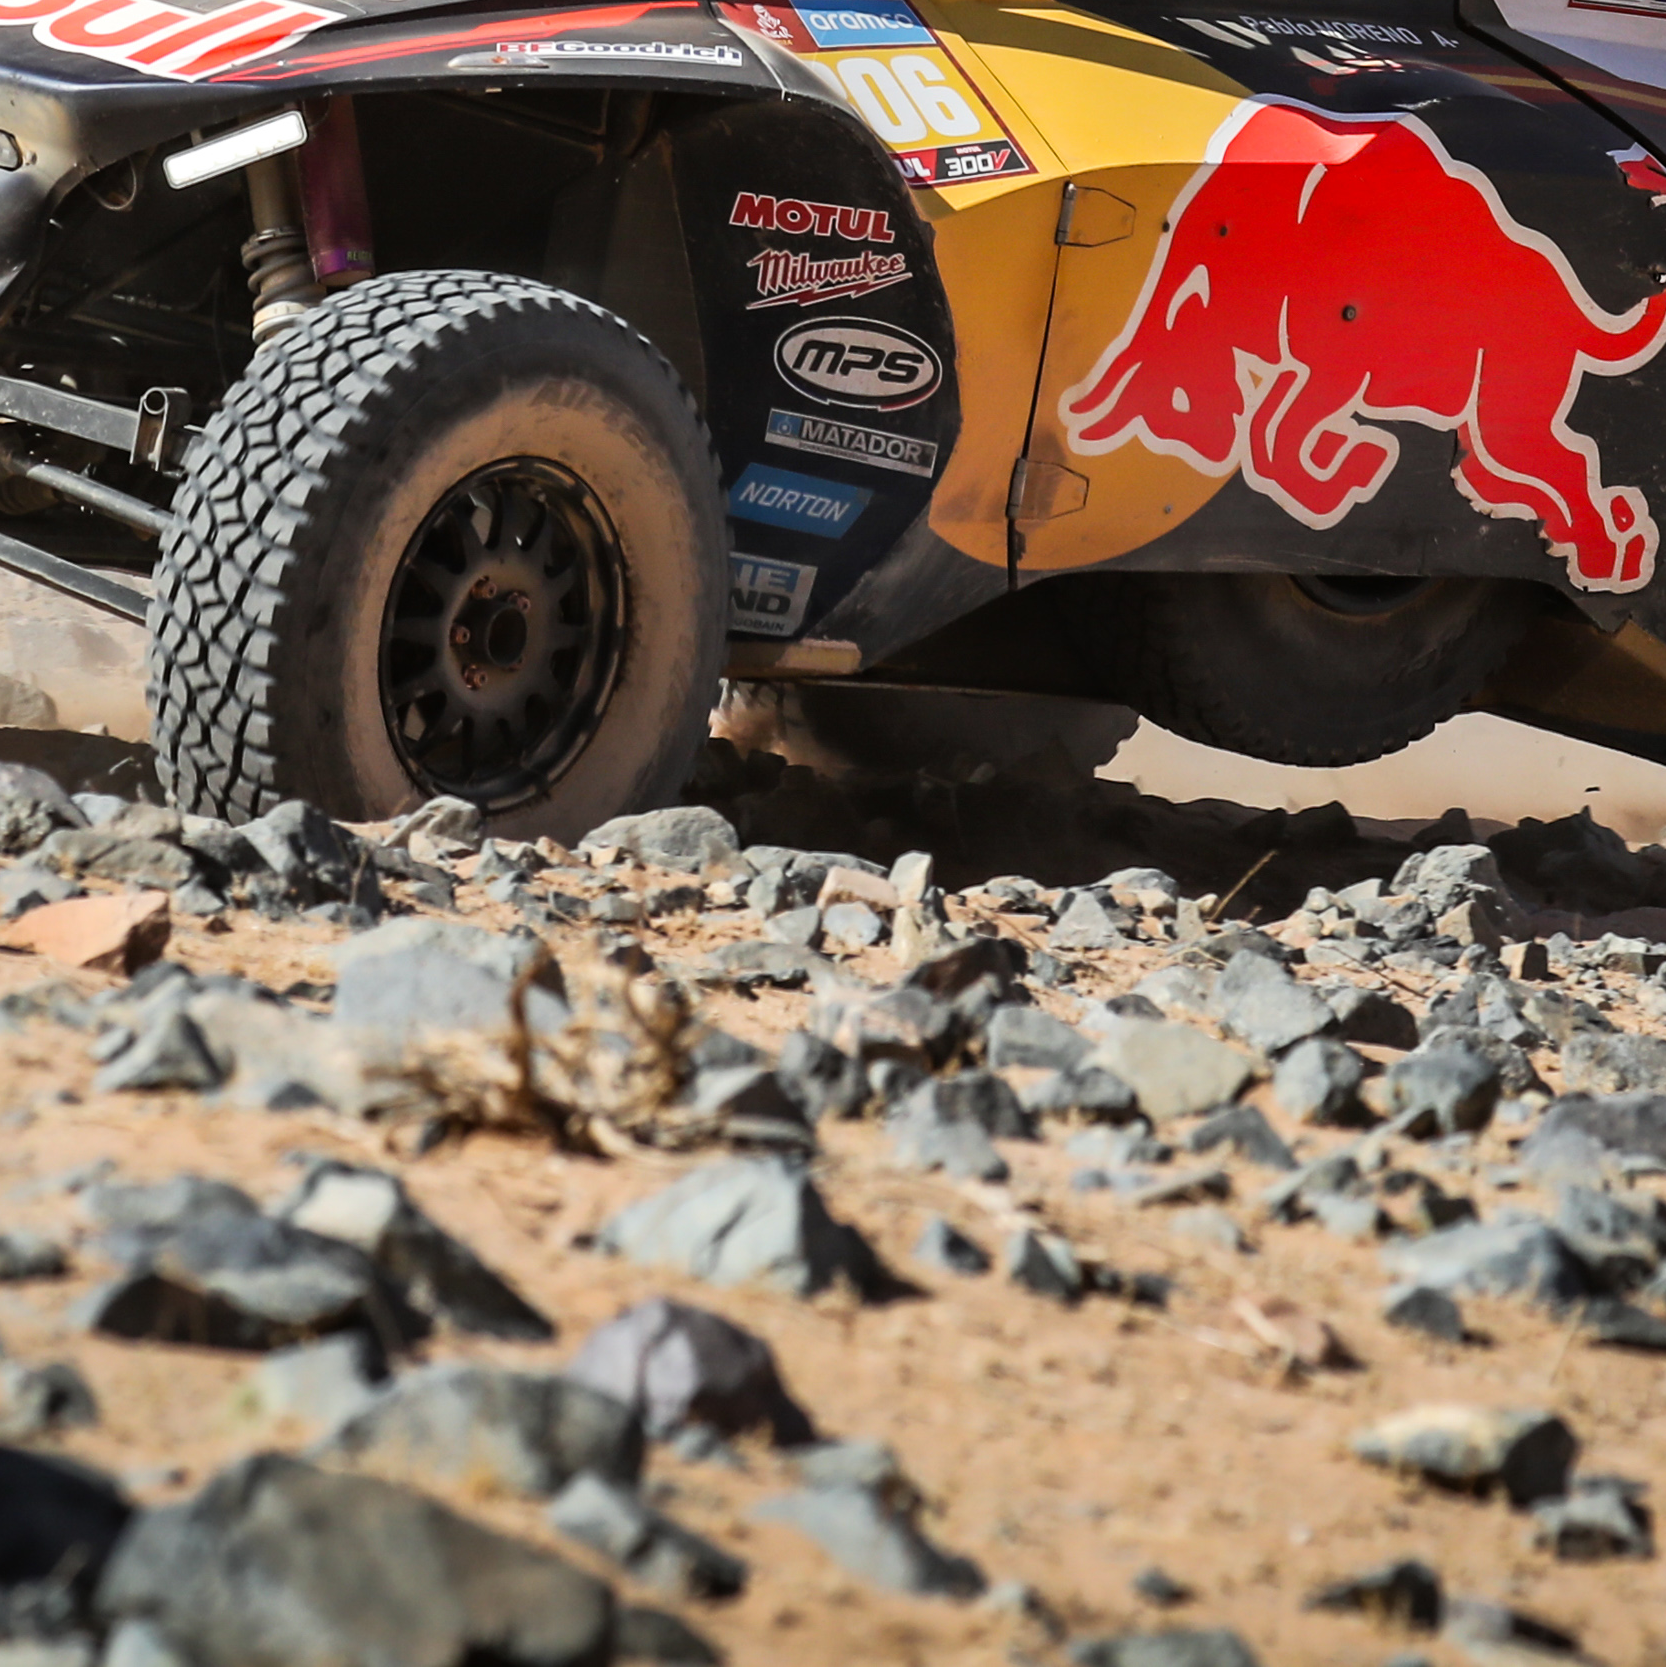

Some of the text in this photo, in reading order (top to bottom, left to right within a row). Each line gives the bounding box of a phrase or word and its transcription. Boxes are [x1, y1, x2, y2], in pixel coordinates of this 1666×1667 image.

[808, 11, 914, 31] aramco
[1238, 15, 1317, 37] Pablo
[1312, 20, 1423, 46] MORENO
[498, 40, 742, 65] BFGoodrich
[944, 149, 1011, 177] 300V
[729, 192, 895, 243] MOTUL
[747, 249, 905, 297] Milwaukee
[791, 338, 926, 383] MPS
[801, 419, 923, 465] MATADOR
[738, 481, 851, 522] NORTON
